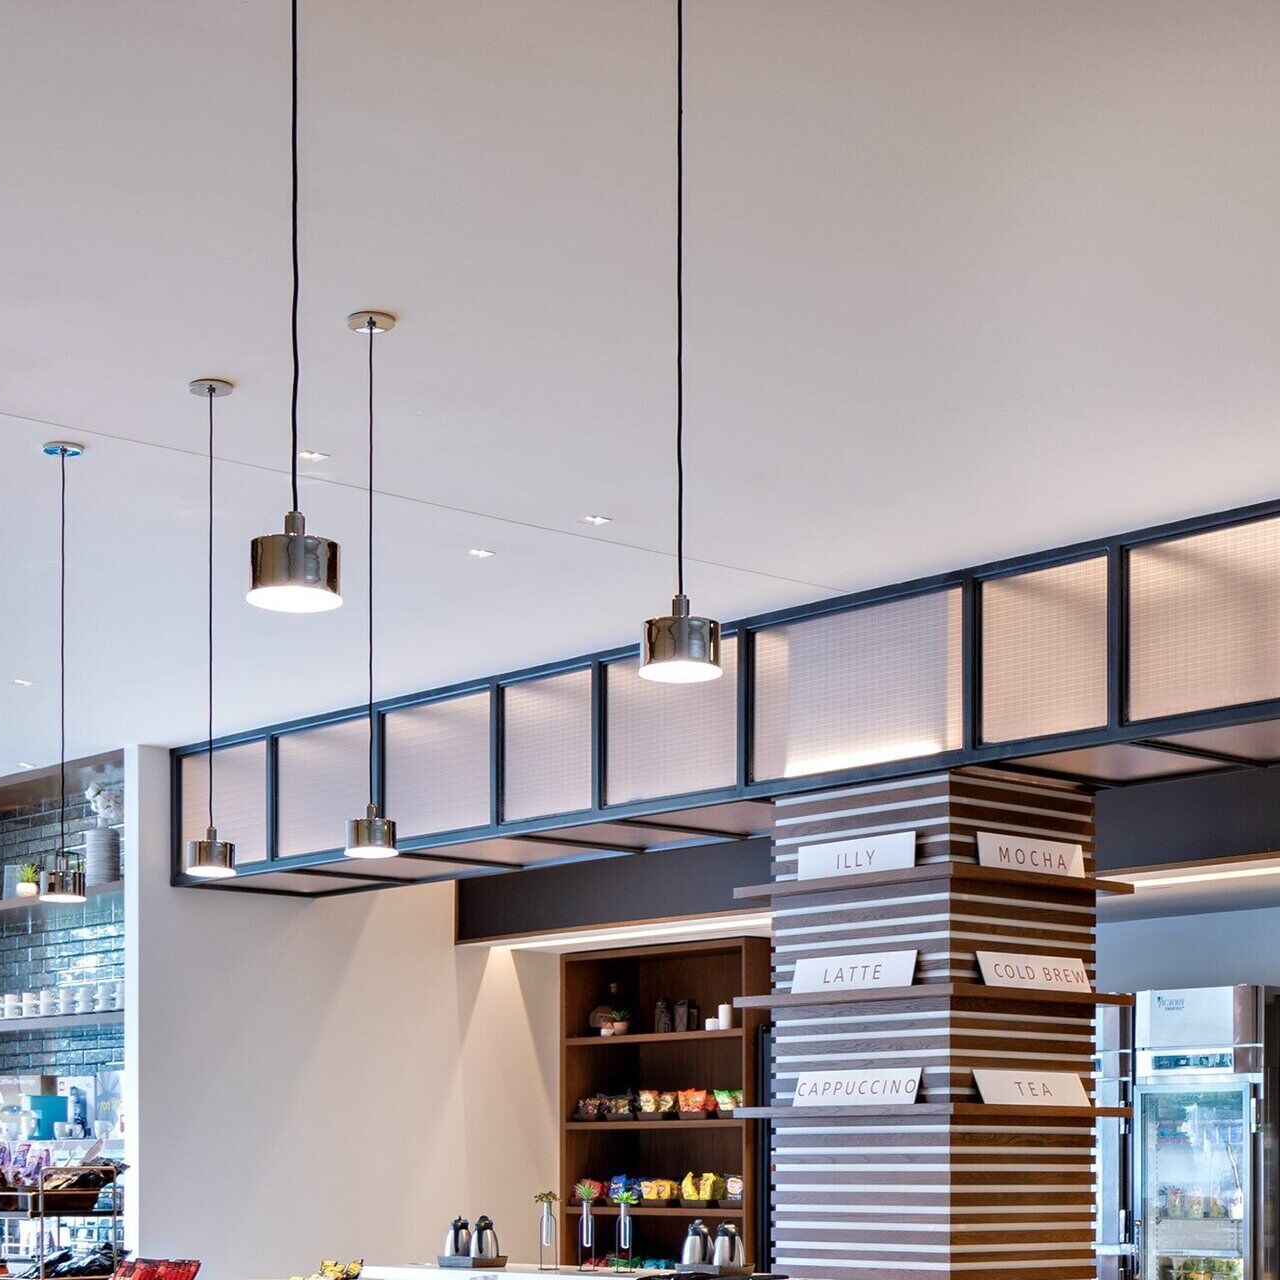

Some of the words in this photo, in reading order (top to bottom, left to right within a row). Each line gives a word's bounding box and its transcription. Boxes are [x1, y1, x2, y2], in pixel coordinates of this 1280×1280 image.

[836, 849, 876, 870] ILLY
[998, 846, 1067, 870] MOCHA
[822, 964, 883, 984] LATTE
[993, 963, 1036, 980] COLD
[1042, 967, 1086, 984] BREW
[797, 1079, 917, 1097] CAPPUCCINO
[1014, 1081, 1053, 1097] TEA
